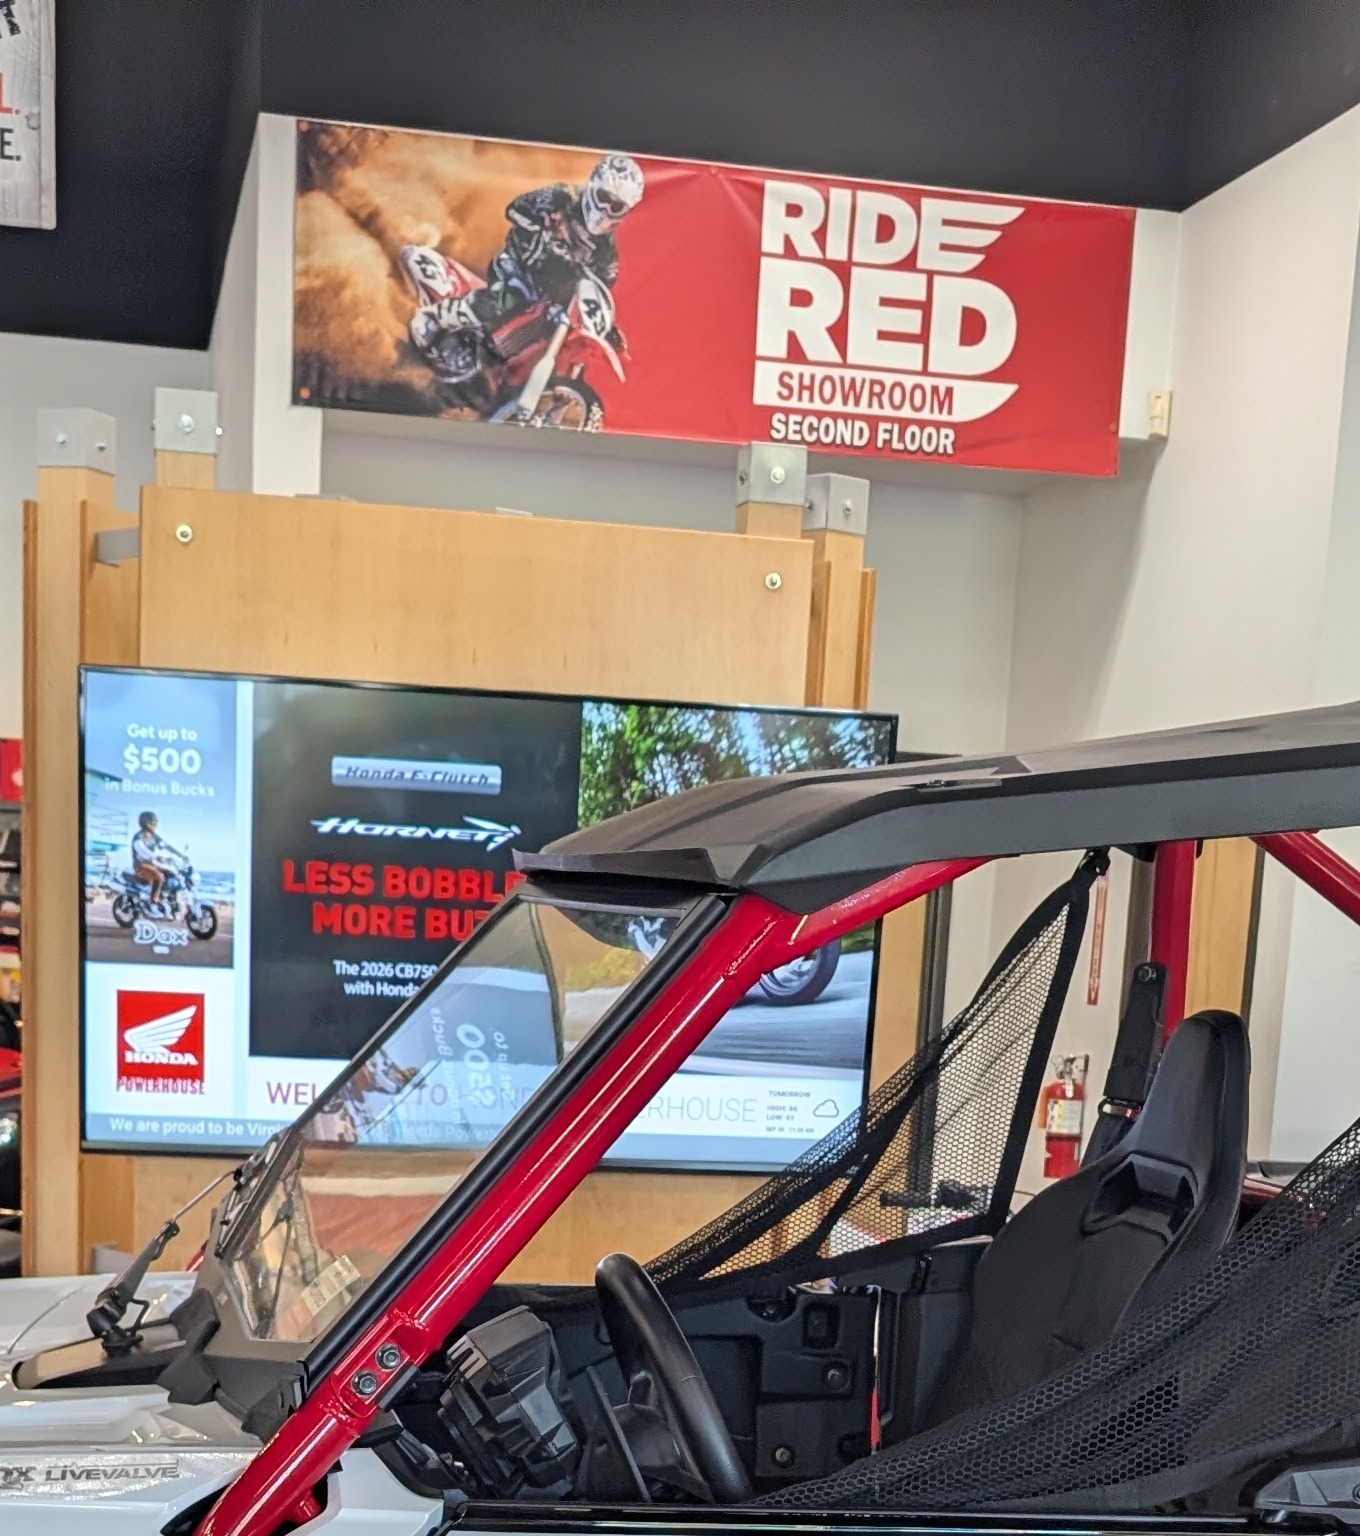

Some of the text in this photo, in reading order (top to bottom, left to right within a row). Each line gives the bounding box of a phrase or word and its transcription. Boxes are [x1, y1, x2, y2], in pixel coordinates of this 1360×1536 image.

[761, 180, 1025, 274] RIDE
[755, 258, 1017, 376] RED
[778, 372, 955, 417] SHOWROOM
[770, 414, 956, 457] SECOND FLOOR
[127, 723, 198, 742] Get up to
[123, 743, 202, 775] $500
[104, 777, 216, 797] in Bonus Bucks
[345, 766, 491, 787] Honda E-Clutch
[283, 860, 375, 896] LESS
[312, 902, 416, 939] MORE
[133, 920, 189, 945] Dax
[334, 959, 359, 976] The
[361, 963, 393, 978] 2026
[344, 982, 373, 996] with
[124, 1051, 199, 1066] HONDA
[116, 1075, 205, 1095] POWERHOUSE
[109, 1117, 134, 1132] We
[136, 1121, 160, 1133] are
[163, 1119, 206, 1136] proud
[208, 1120, 225, 1134] to
[226, 1120, 244, 1135] be
